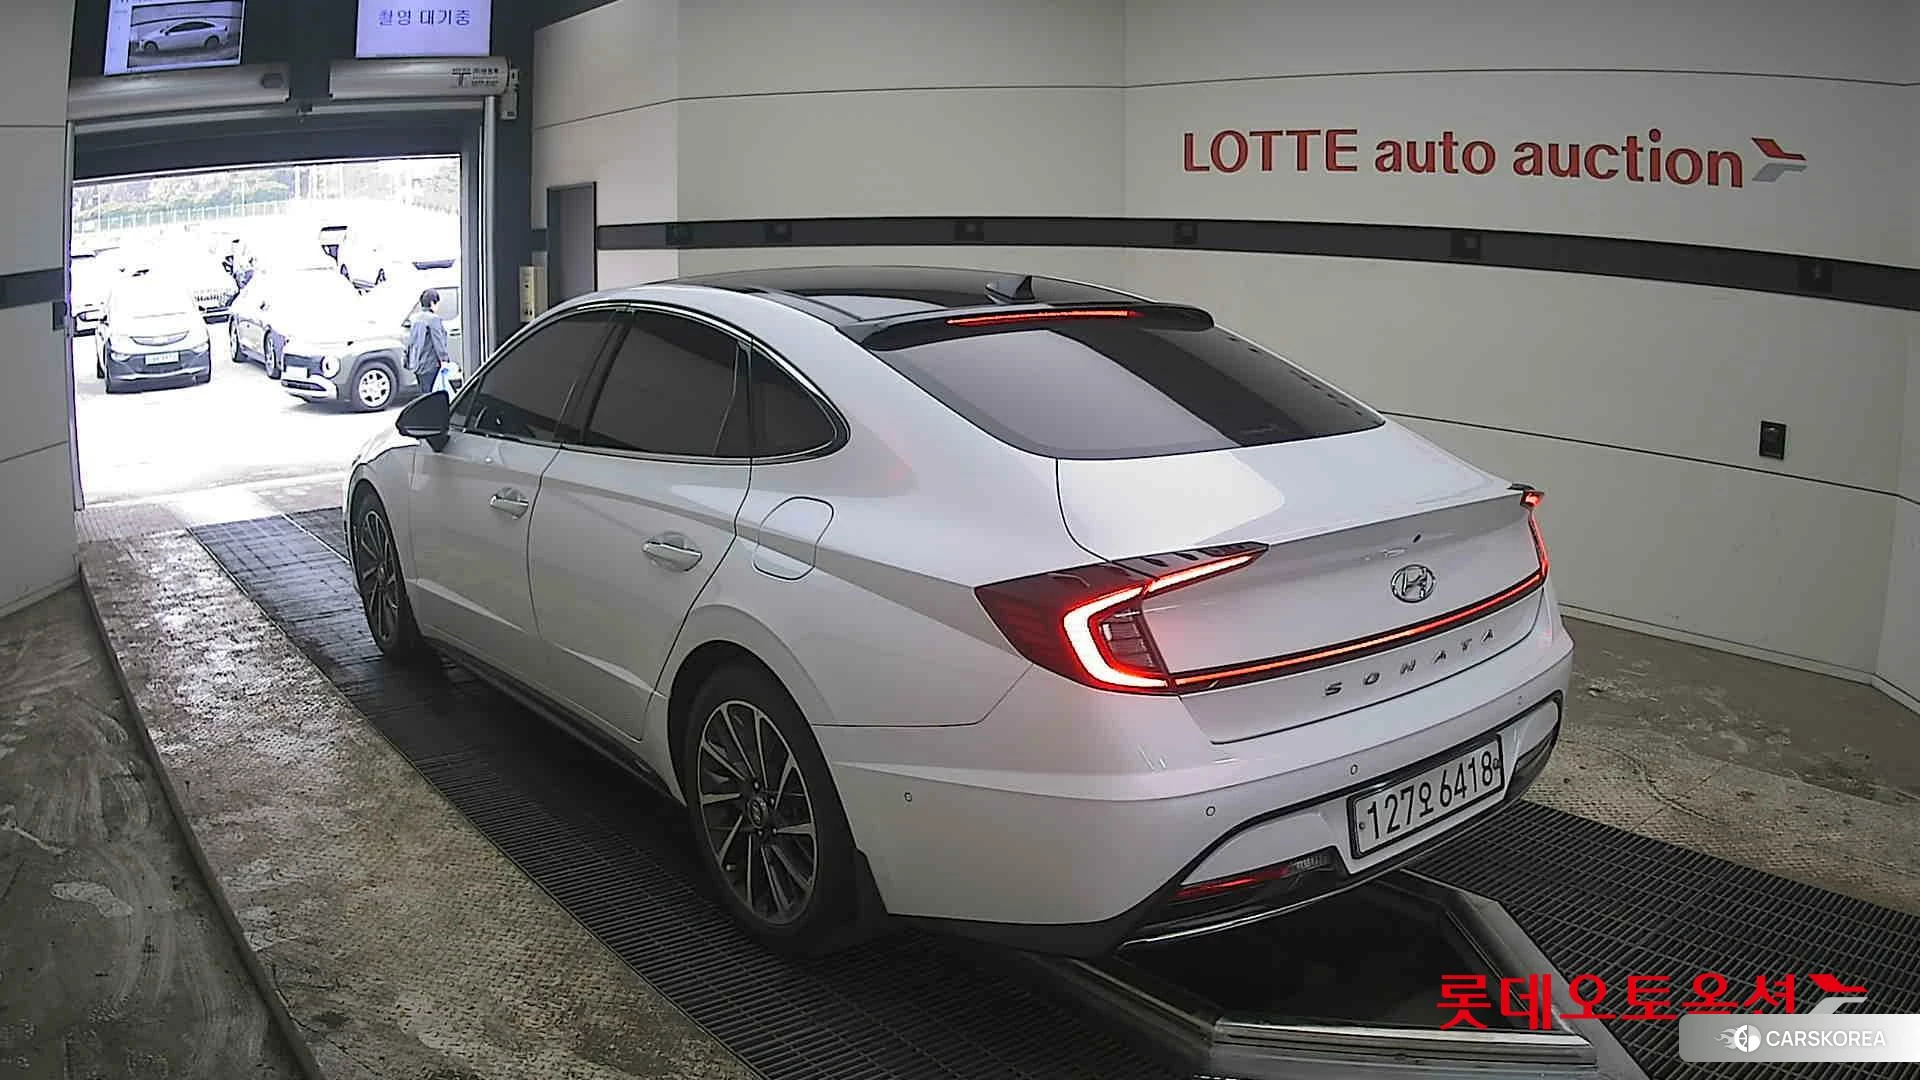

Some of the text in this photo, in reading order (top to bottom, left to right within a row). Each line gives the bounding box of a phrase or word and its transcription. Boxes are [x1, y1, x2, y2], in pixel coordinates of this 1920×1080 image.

[419, 8, 471, 27] 대기중
[1184, 129, 1743, 187] LOTTE auto auction
[1323, 628, 1495, 698] SONATA
